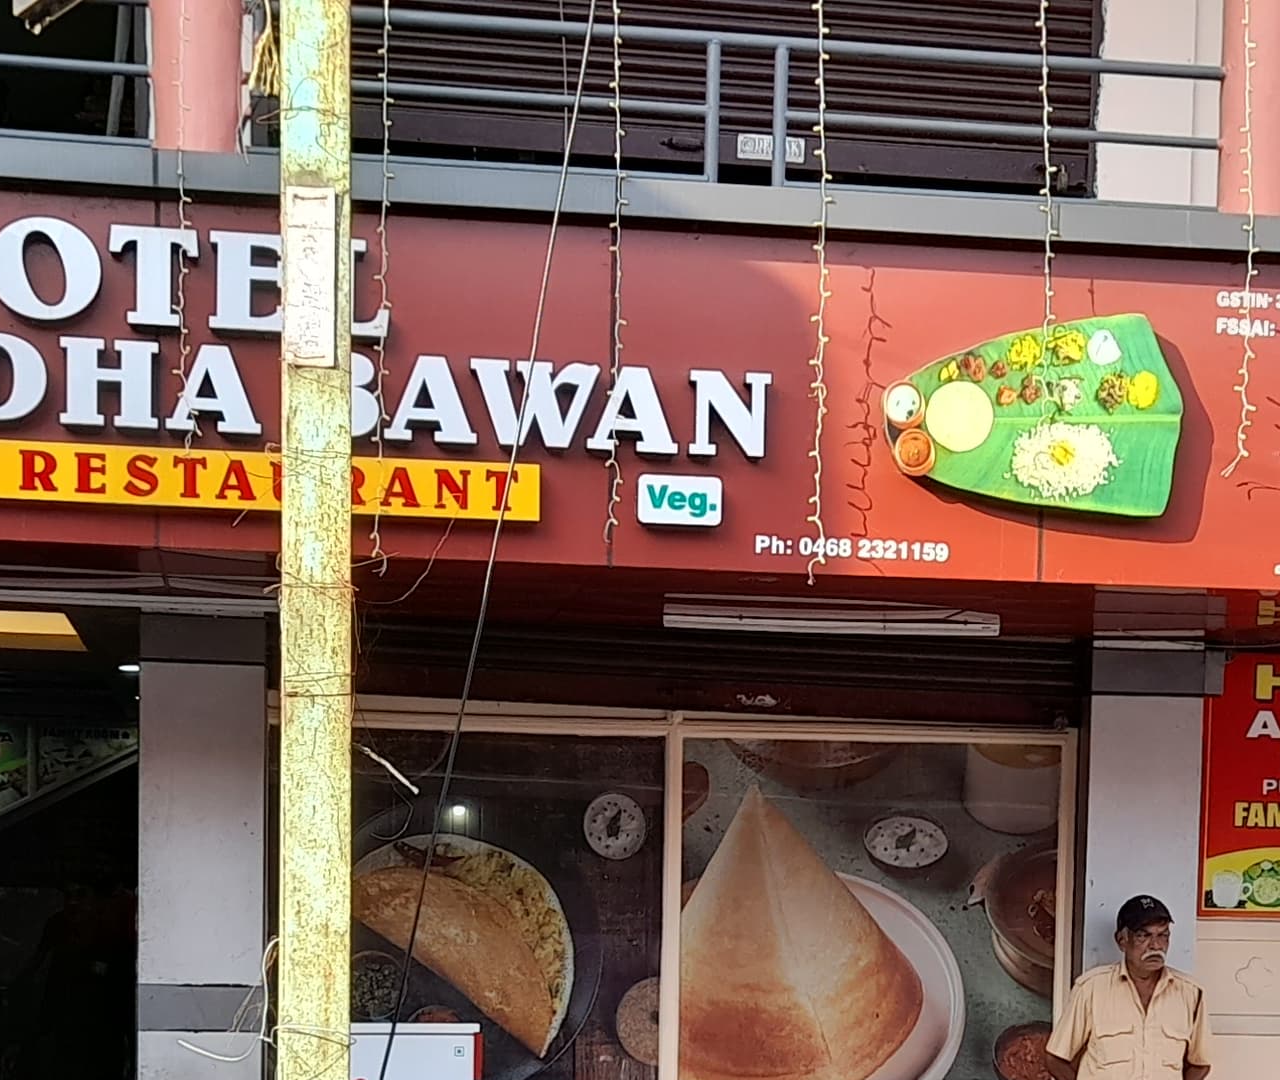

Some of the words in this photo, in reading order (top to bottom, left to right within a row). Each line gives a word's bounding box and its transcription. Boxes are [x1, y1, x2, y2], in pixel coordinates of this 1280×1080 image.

[18, 448, 521, 512] RESTAANT
[646, 483, 717, 518] Veg.
[755, 535, 794, 555] Ph:
[799, 537, 852, 558] 0468
[857, 538, 949, 563] 2321159
